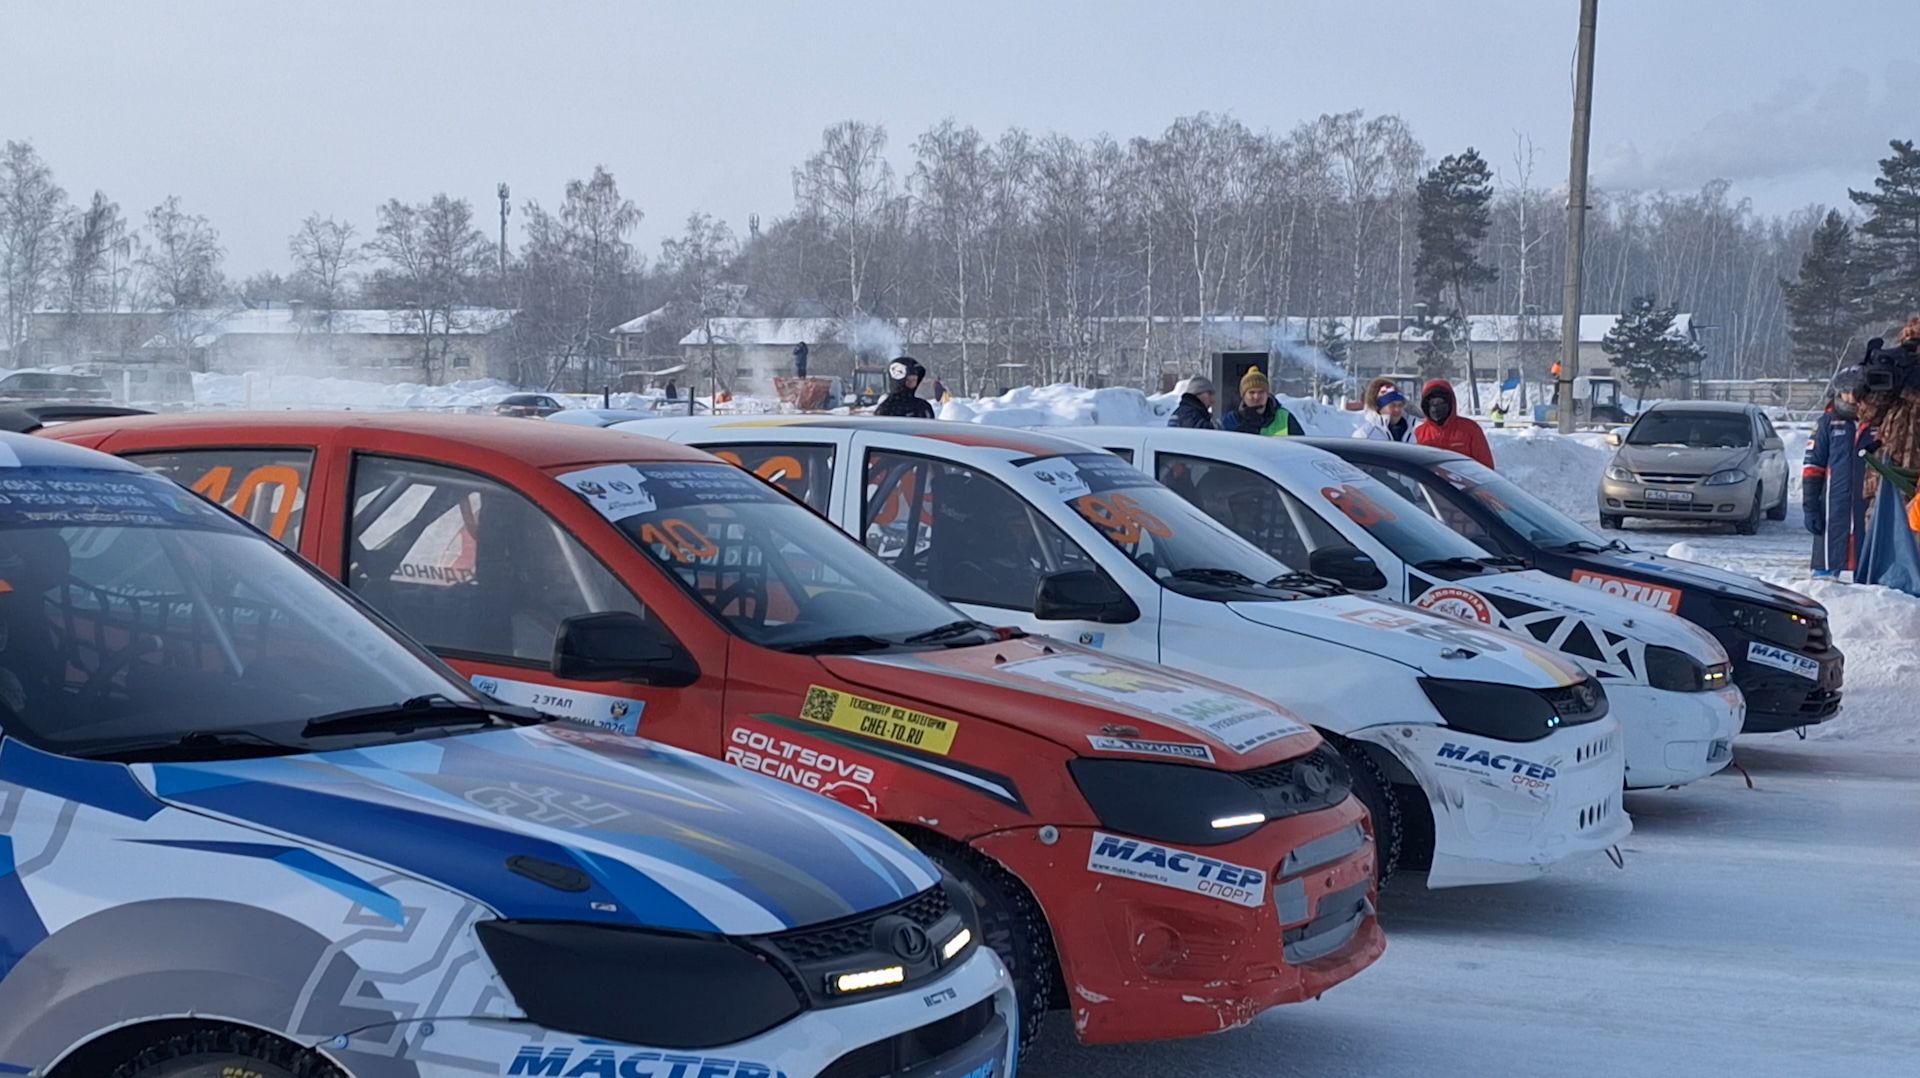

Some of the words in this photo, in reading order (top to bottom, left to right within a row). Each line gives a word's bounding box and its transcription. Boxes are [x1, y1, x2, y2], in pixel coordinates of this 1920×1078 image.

[641, 519, 717, 563] 10
[1578, 575, 1673, 611] MOTUL
[1751, 644, 1817, 670] МАСТЕР
[532, 694, 540, 704] 2
[542, 697, 573, 709] ЭТАП
[860, 716, 924, 745] CHEL-TO.RU
[1437, 742, 1556, 780] МАСТЕР
[1511, 775, 1551, 792] СПОРТ
[1095, 836, 1263, 888] МАСТЕР
[1197, 880, 1253, 903] СПОРТ
